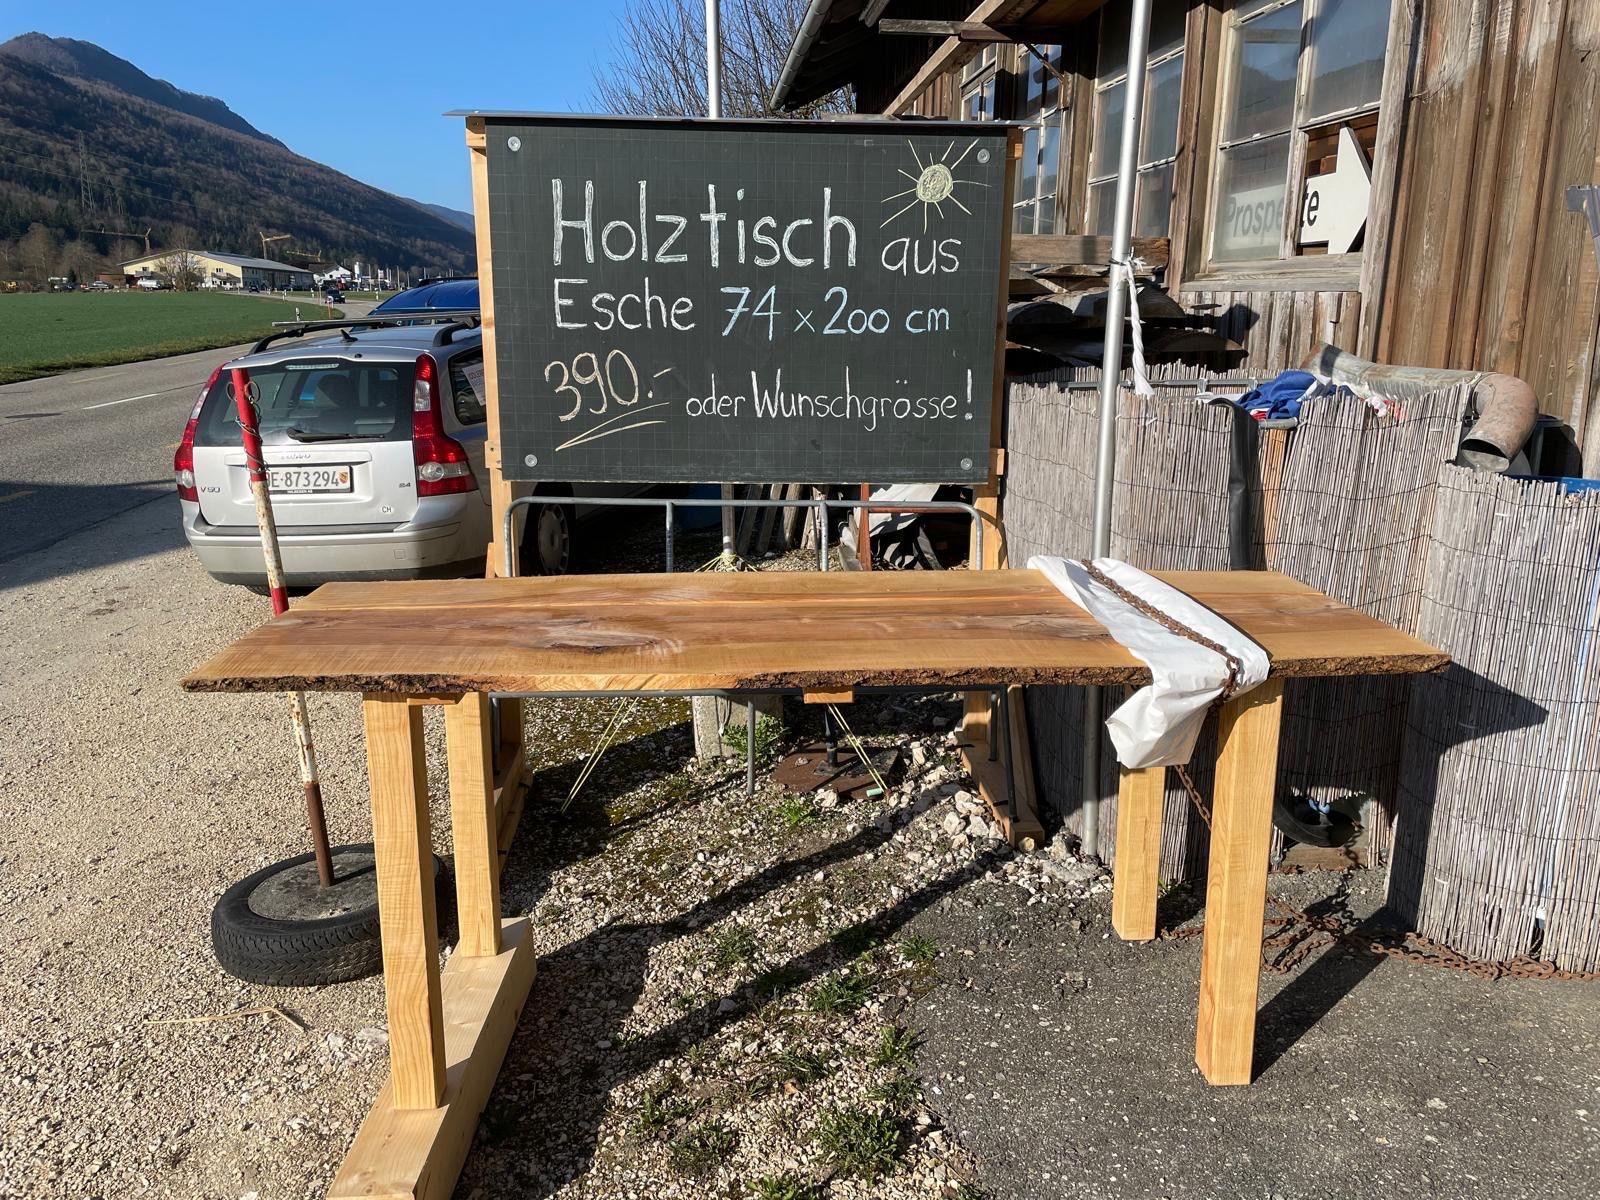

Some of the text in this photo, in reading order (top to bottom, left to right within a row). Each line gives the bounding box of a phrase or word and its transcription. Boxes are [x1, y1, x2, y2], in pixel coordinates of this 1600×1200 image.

[551, 178, 961, 276] Holztisch aus
[554, 278, 695, 331] Esche
[720, 285, 781, 341] 74
[823, 286, 890, 335] 200
[905, 307, 950, 334] cm
[686, 373, 745, 417] oder
[751, 366, 973, 432] Wunschgrösse!
[381, 505, 392, 513] CH
